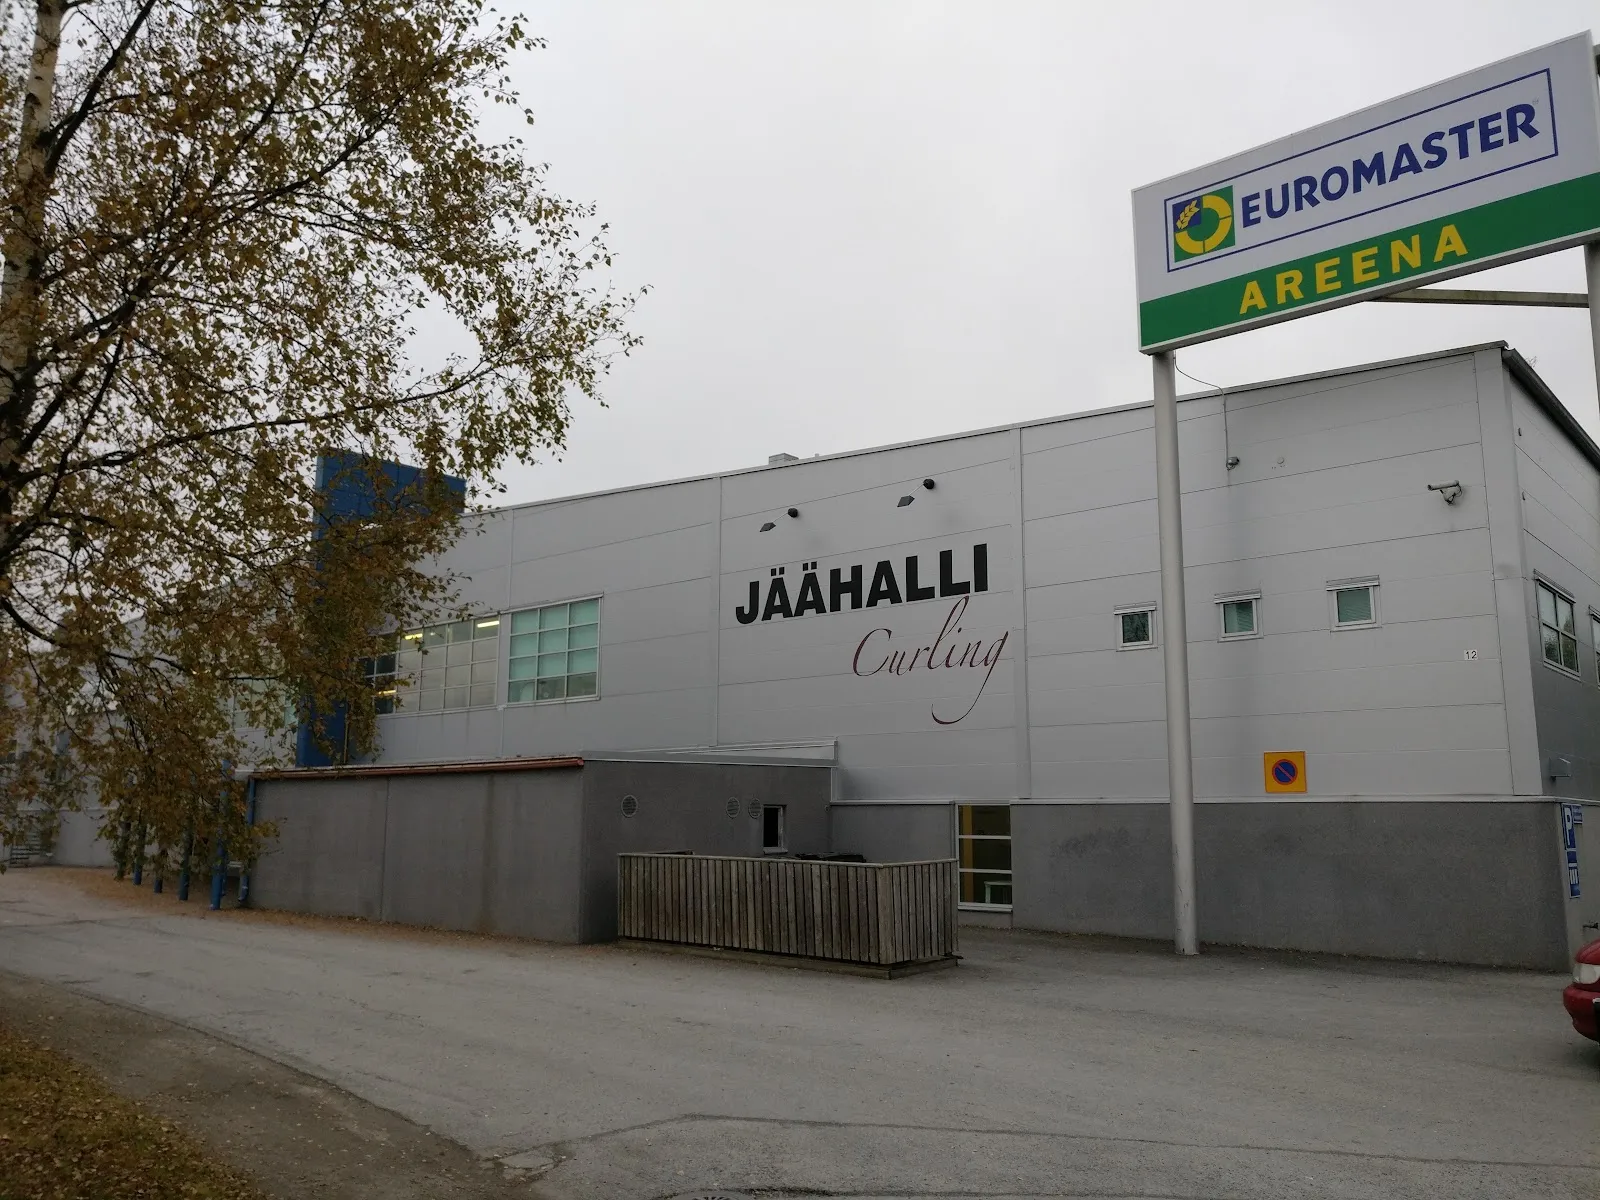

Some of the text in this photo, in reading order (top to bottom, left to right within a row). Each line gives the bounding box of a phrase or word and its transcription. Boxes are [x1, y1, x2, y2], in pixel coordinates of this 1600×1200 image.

[1241, 103, 1540, 228] EUROMASTER
[1239, 224, 1469, 315] AREENA
[735, 543, 988, 625] JÄÄHALLI
[852, 595, 1009, 725] Curling
[1465, 650, 1478, 660] 12
[1564, 807, 1573, 846] P
